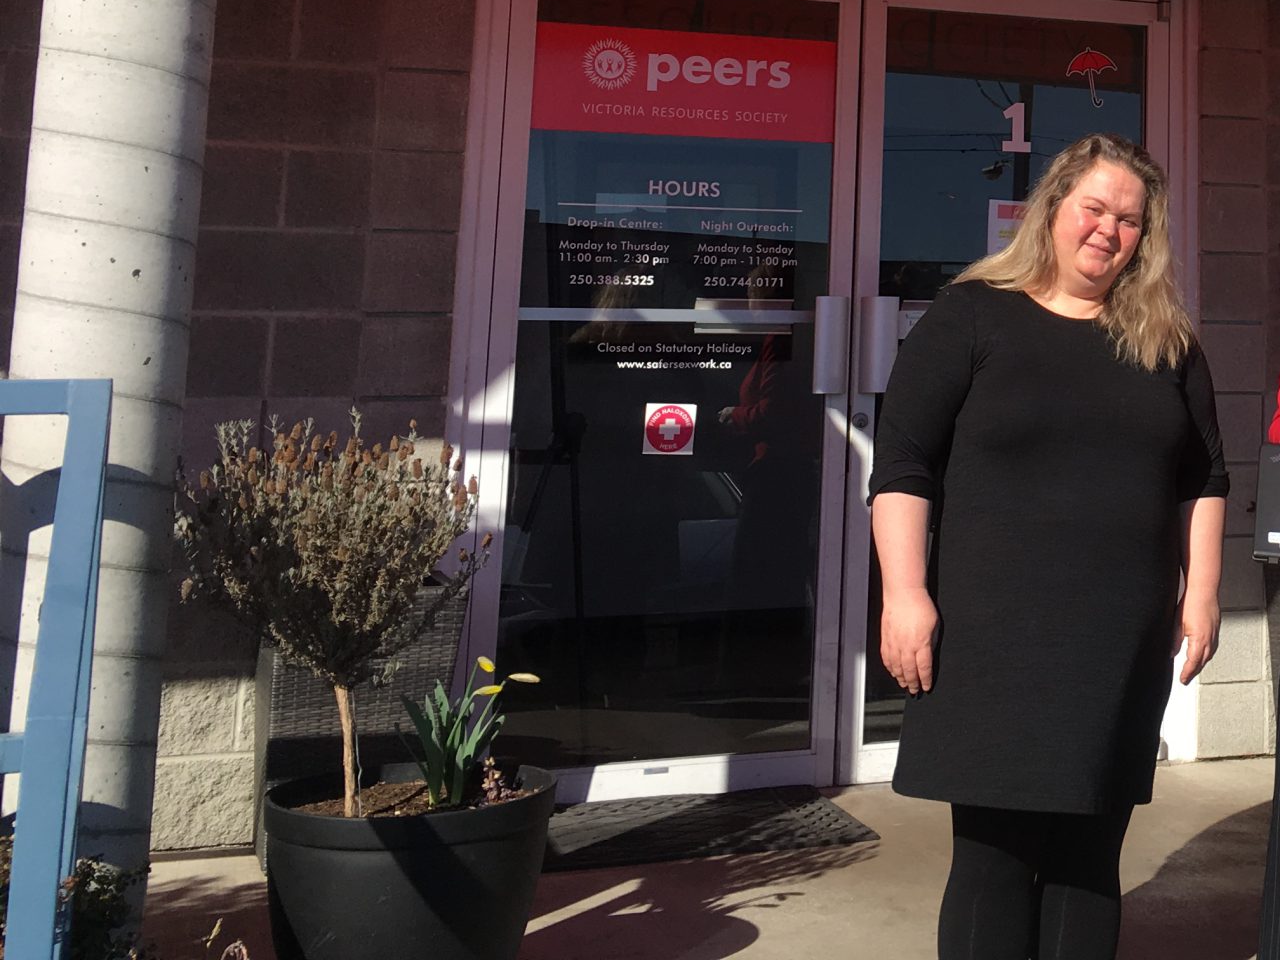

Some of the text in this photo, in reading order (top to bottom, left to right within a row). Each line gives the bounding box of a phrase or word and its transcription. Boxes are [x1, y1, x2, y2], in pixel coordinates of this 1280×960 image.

[647, 52, 791, 91] peers
[582, 103, 788, 123] VICTORIA RESOURCES SOCIETY
[1002, 102, 1031, 153] 1
[649, 180, 721, 198] HOURS
[567, 217, 663, 229] Drop-in Centre:
[701, 221, 794, 232] Night Outreach:
[559, 240, 670, 253] Monday to Thursday
[697, 243, 794, 256] Monday to Sunday
[560, 252, 592, 262] 11:00
[595, 255, 612, 263] am
[623, 253, 649, 263] 2:30
[652, 256, 669, 266] pm
[693, 255, 717, 265] 7:00
[720, 258, 737, 267] pm
[749, 256, 779, 266] 11:00
[781, 260, 798, 268] pm
[569, 274, 655, 286] 250.388.5325
[704, 276, 784, 287] 250.744.0171
[597, 343, 635, 353] Closed
[655, 343, 703, 355] Statutory
[706, 344, 752, 355] Holidays
[617, 359, 732, 369] www.safersexwork.ca
[649, 408, 691, 427] FIND NALOXONE
